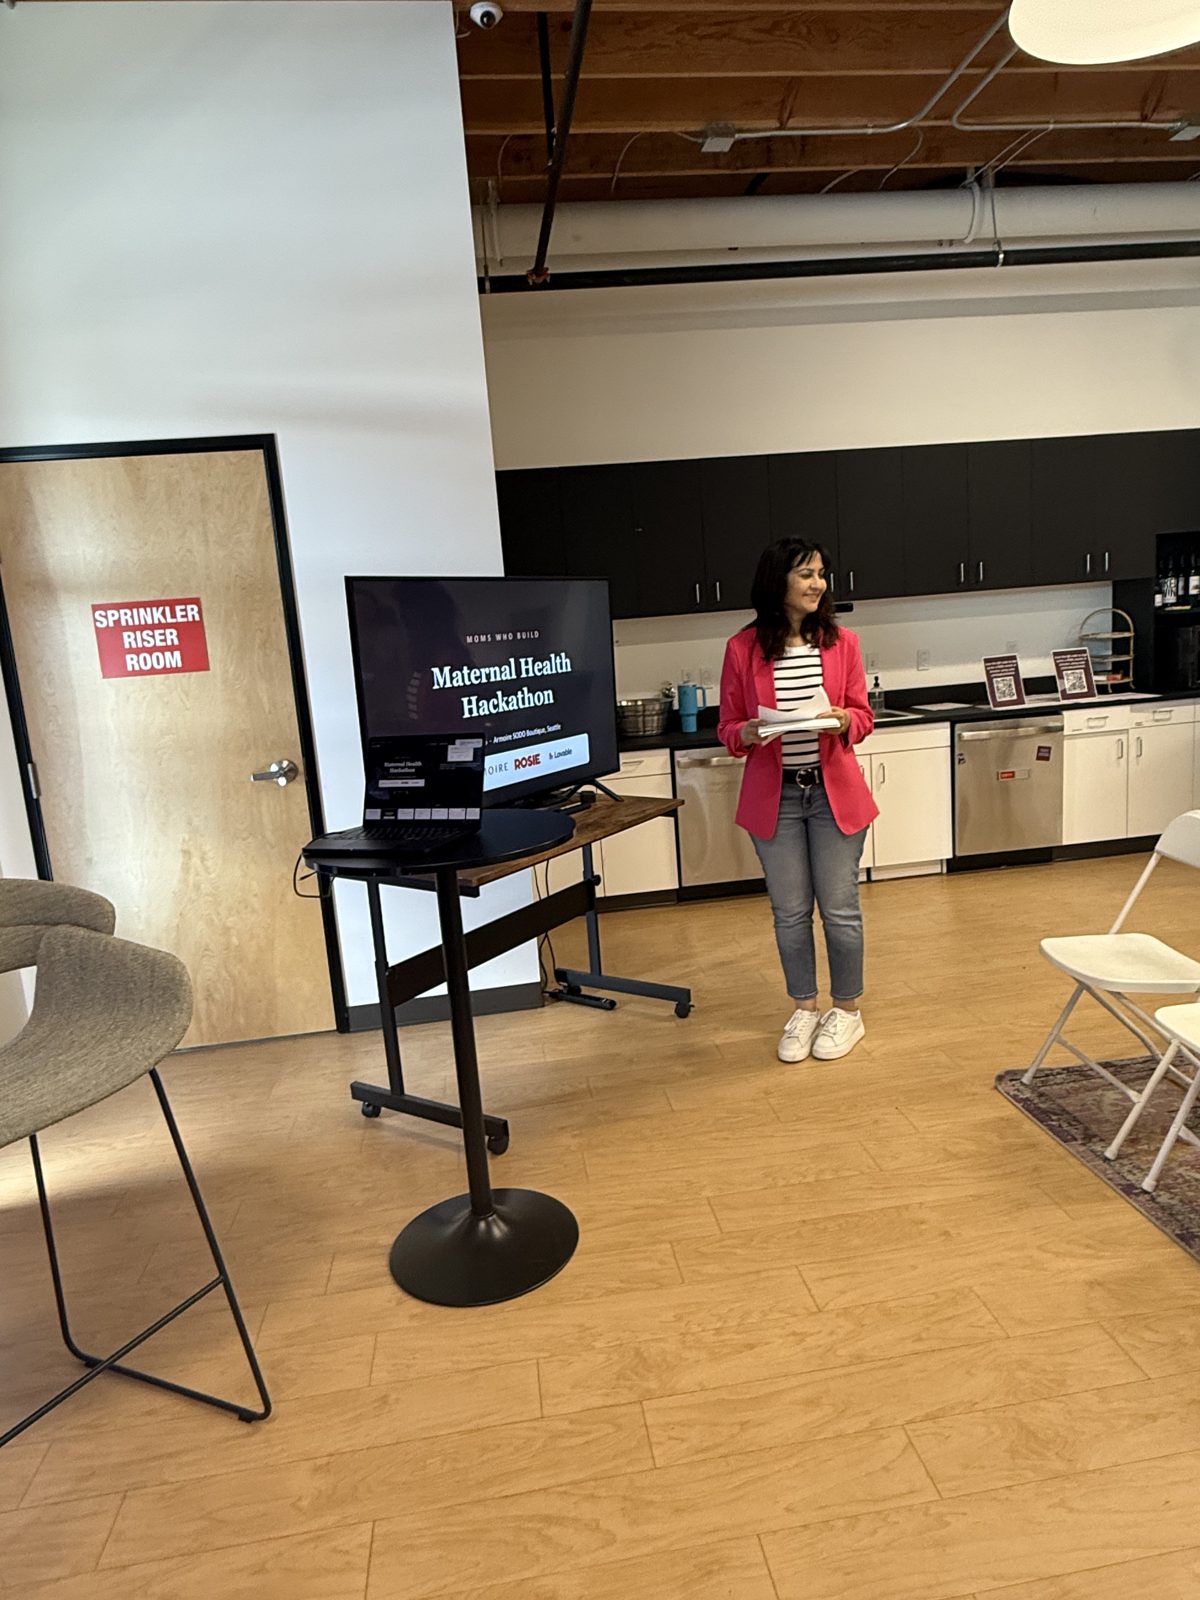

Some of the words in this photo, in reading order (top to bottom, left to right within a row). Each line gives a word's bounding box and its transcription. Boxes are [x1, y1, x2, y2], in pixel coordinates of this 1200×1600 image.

[94, 604, 200, 628] SPRINKLER
[122, 628, 179, 649] RISER
[466, 634, 492, 643] MOMS
[495, 632, 513, 641] WHO
[517, 630, 540, 640] BUILD
[125, 650, 182, 672] ROOM
[431, 657, 517, 690] Maternal
[519, 652, 572, 678] Health
[461, 686, 555, 719] Hackathon
[493, 733, 512, 744] Armoire
[485, 762, 509, 776] OIRE
[513, 753, 541, 771] ROSIE
[554, 747, 573, 759] Lovable
